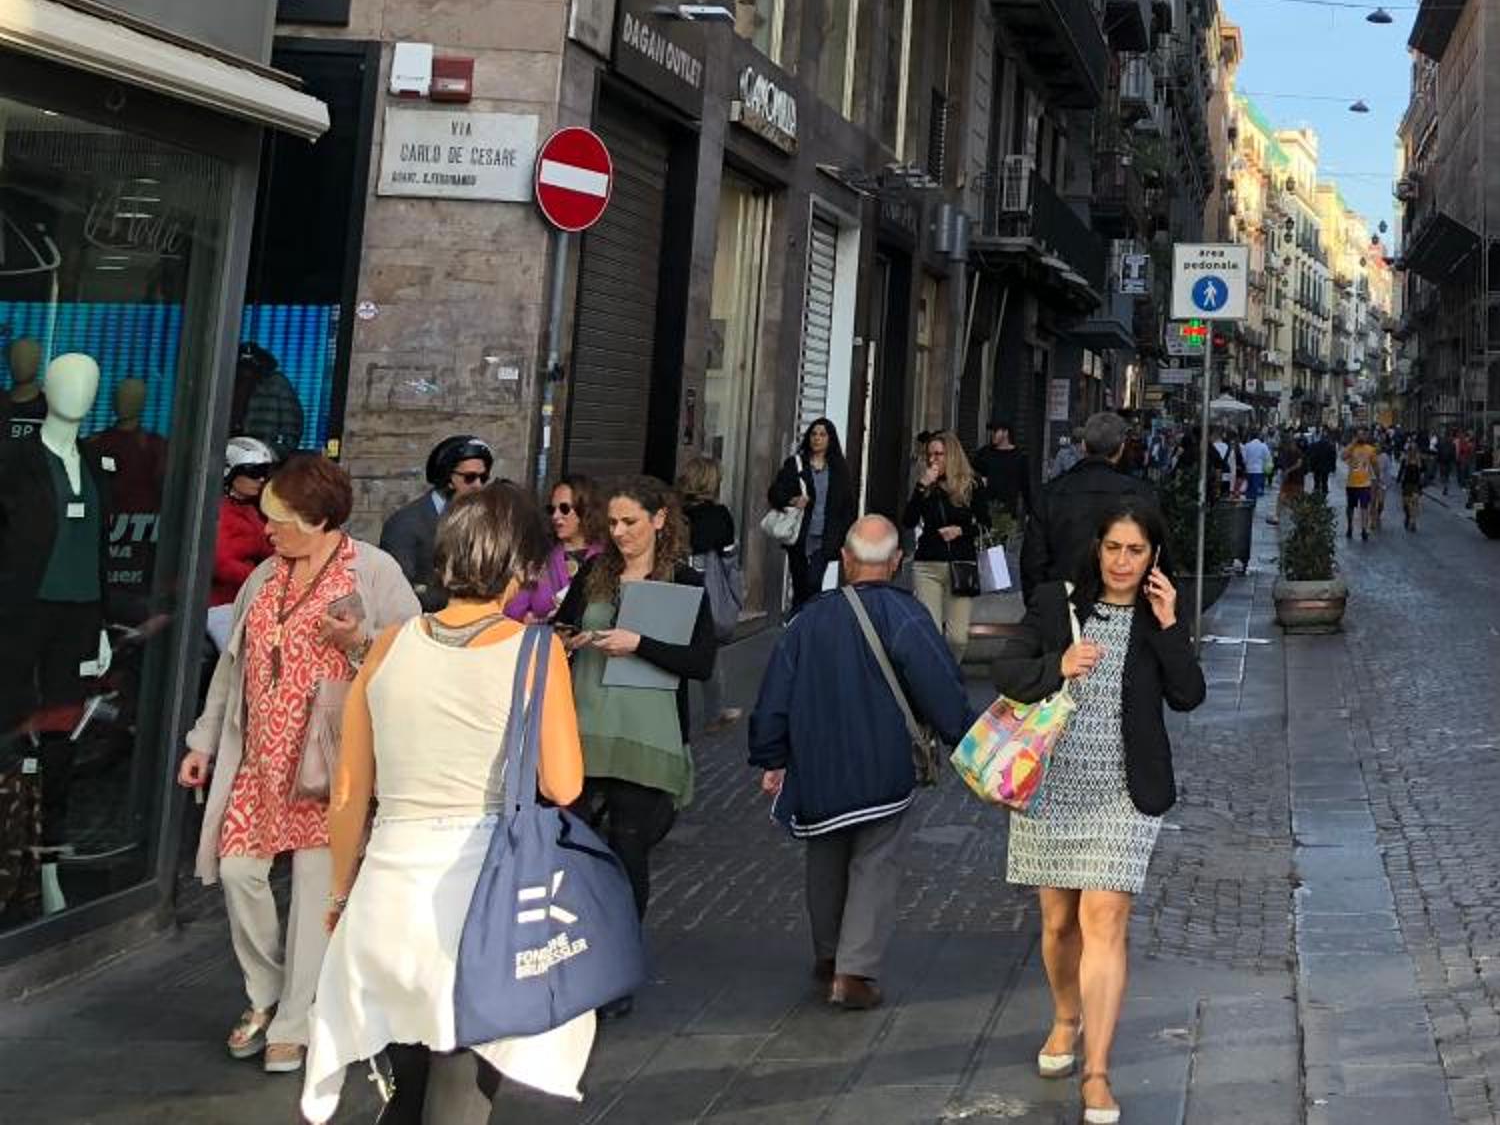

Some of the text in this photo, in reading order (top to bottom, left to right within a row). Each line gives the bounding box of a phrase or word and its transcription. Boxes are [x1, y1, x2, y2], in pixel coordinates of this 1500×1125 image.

[451, 121, 473, 137] VIA
[400, 143, 517, 167] CARLO DE CESARE
[1200, 249, 1225, 258] area
[1183, 260, 1240, 271] pedonale
